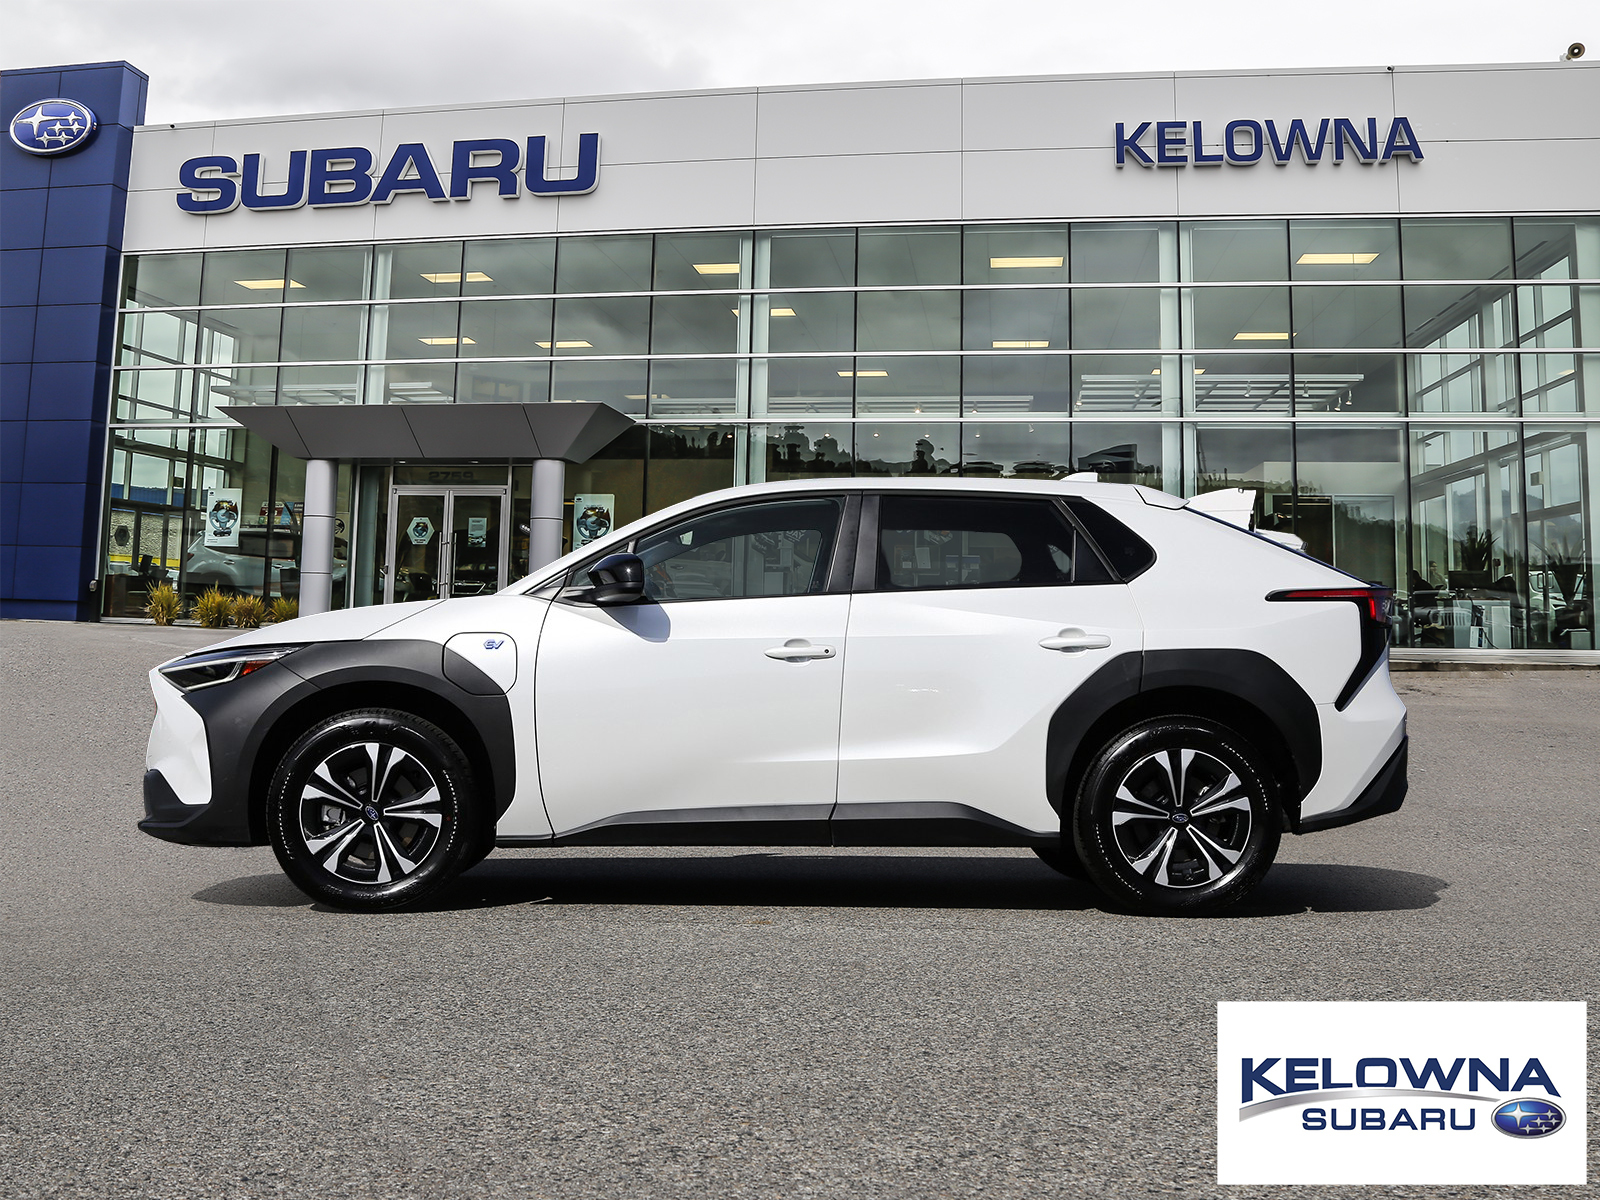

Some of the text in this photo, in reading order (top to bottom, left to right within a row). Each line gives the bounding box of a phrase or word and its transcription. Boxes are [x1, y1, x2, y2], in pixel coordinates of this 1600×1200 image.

[1114, 116, 1424, 167] KELOWNA
[176, 132, 600, 214] SUBARU
[428, 471, 474, 482] 2759
